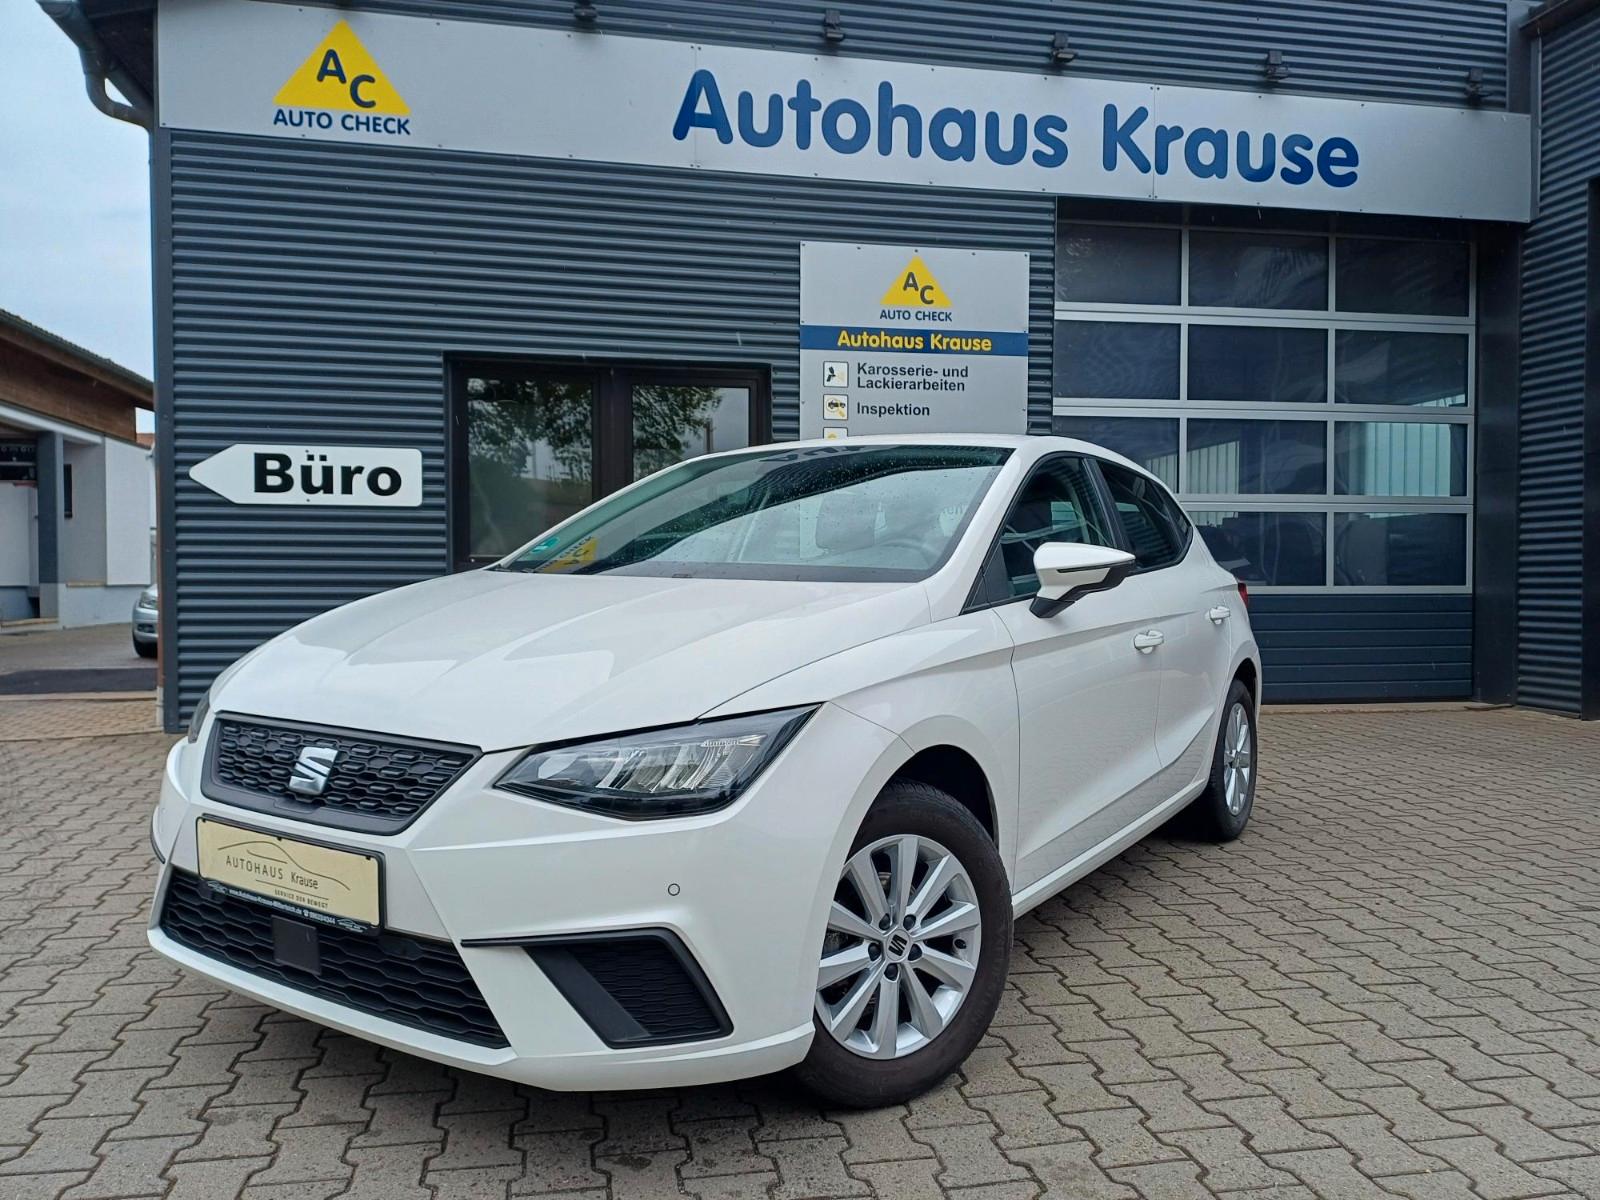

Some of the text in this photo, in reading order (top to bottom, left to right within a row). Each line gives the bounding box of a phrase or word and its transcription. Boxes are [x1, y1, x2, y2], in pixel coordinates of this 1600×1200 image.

[273, 108, 411, 136] AUTO CHECK
[672, 69, 1360, 188] Autohaus Krause
[879, 309, 953, 322] AUTO CHECK
[837, 330, 992, 351] Autohaus Krause
[857, 362, 969, 378] Karosserie- und
[857, 376, 965, 392] Lackierarbeiten
[856, 402, 930, 418] Inspektion
[253, 451, 402, 497] Büro
[225, 855, 319, 890] AUTOHAUS Krause
